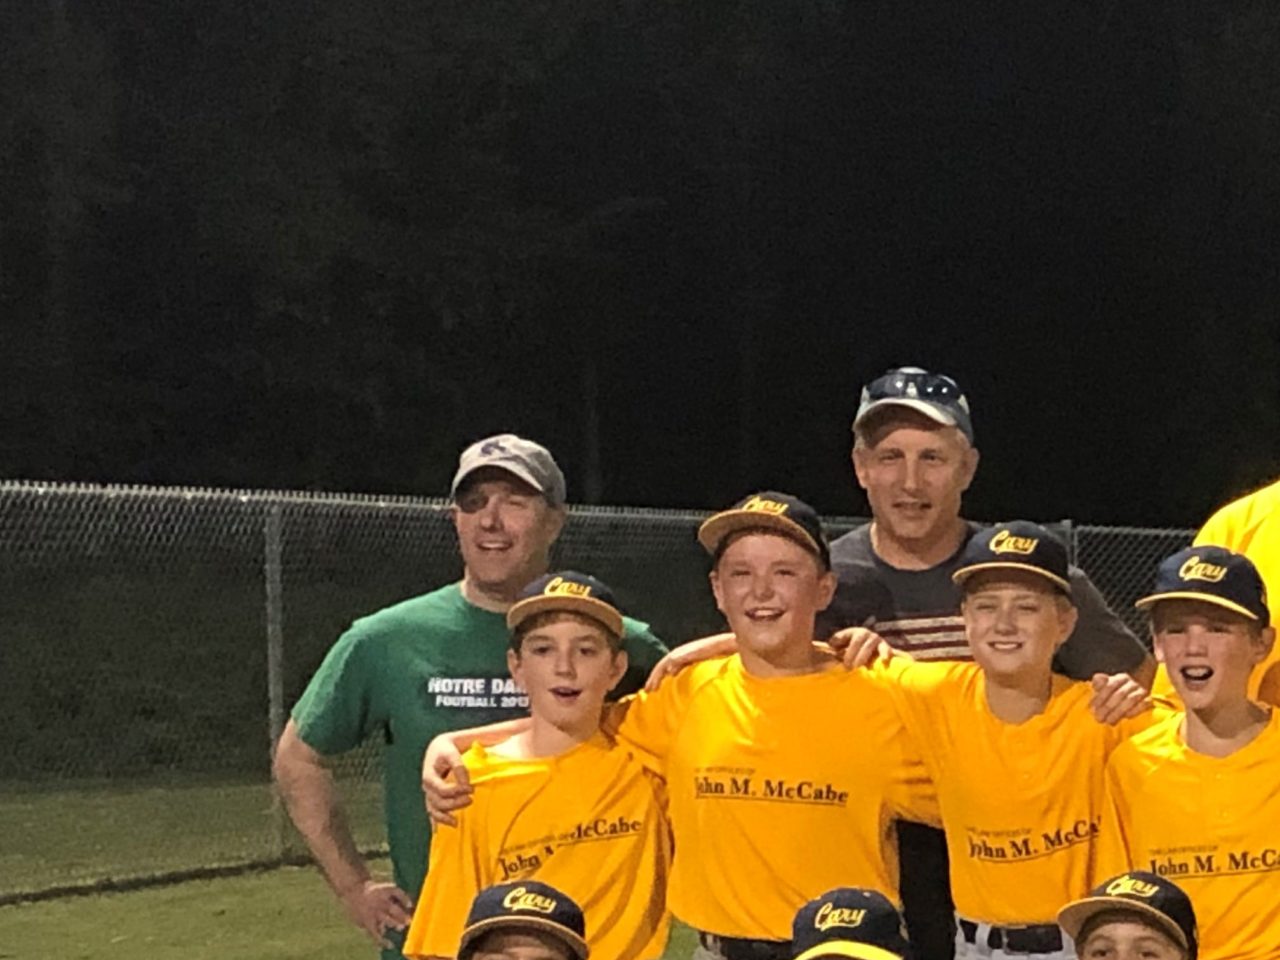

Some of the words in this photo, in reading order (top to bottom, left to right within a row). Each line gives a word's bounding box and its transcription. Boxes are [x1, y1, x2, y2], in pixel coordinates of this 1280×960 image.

[989, 530, 1039, 554] Cary
[1179, 556, 1228, 582] Cary
[428, 677, 485, 694] NOTRE
[491, 678, 528, 694] DA
[436, 695, 497, 707] FOOTBALL
[730, 778, 757, 796] M.
[764, 779, 848, 803] McCabe
[1010, 838, 1038, 858] M.
[1042, 816, 1101, 851] McCa
[1151, 857, 1188, 877] John
[1194, 855, 1221, 873] M.
[1106, 875, 1159, 898] Cary
[503, 887, 557, 913] Cary
[814, 902, 866, 931] Cary
